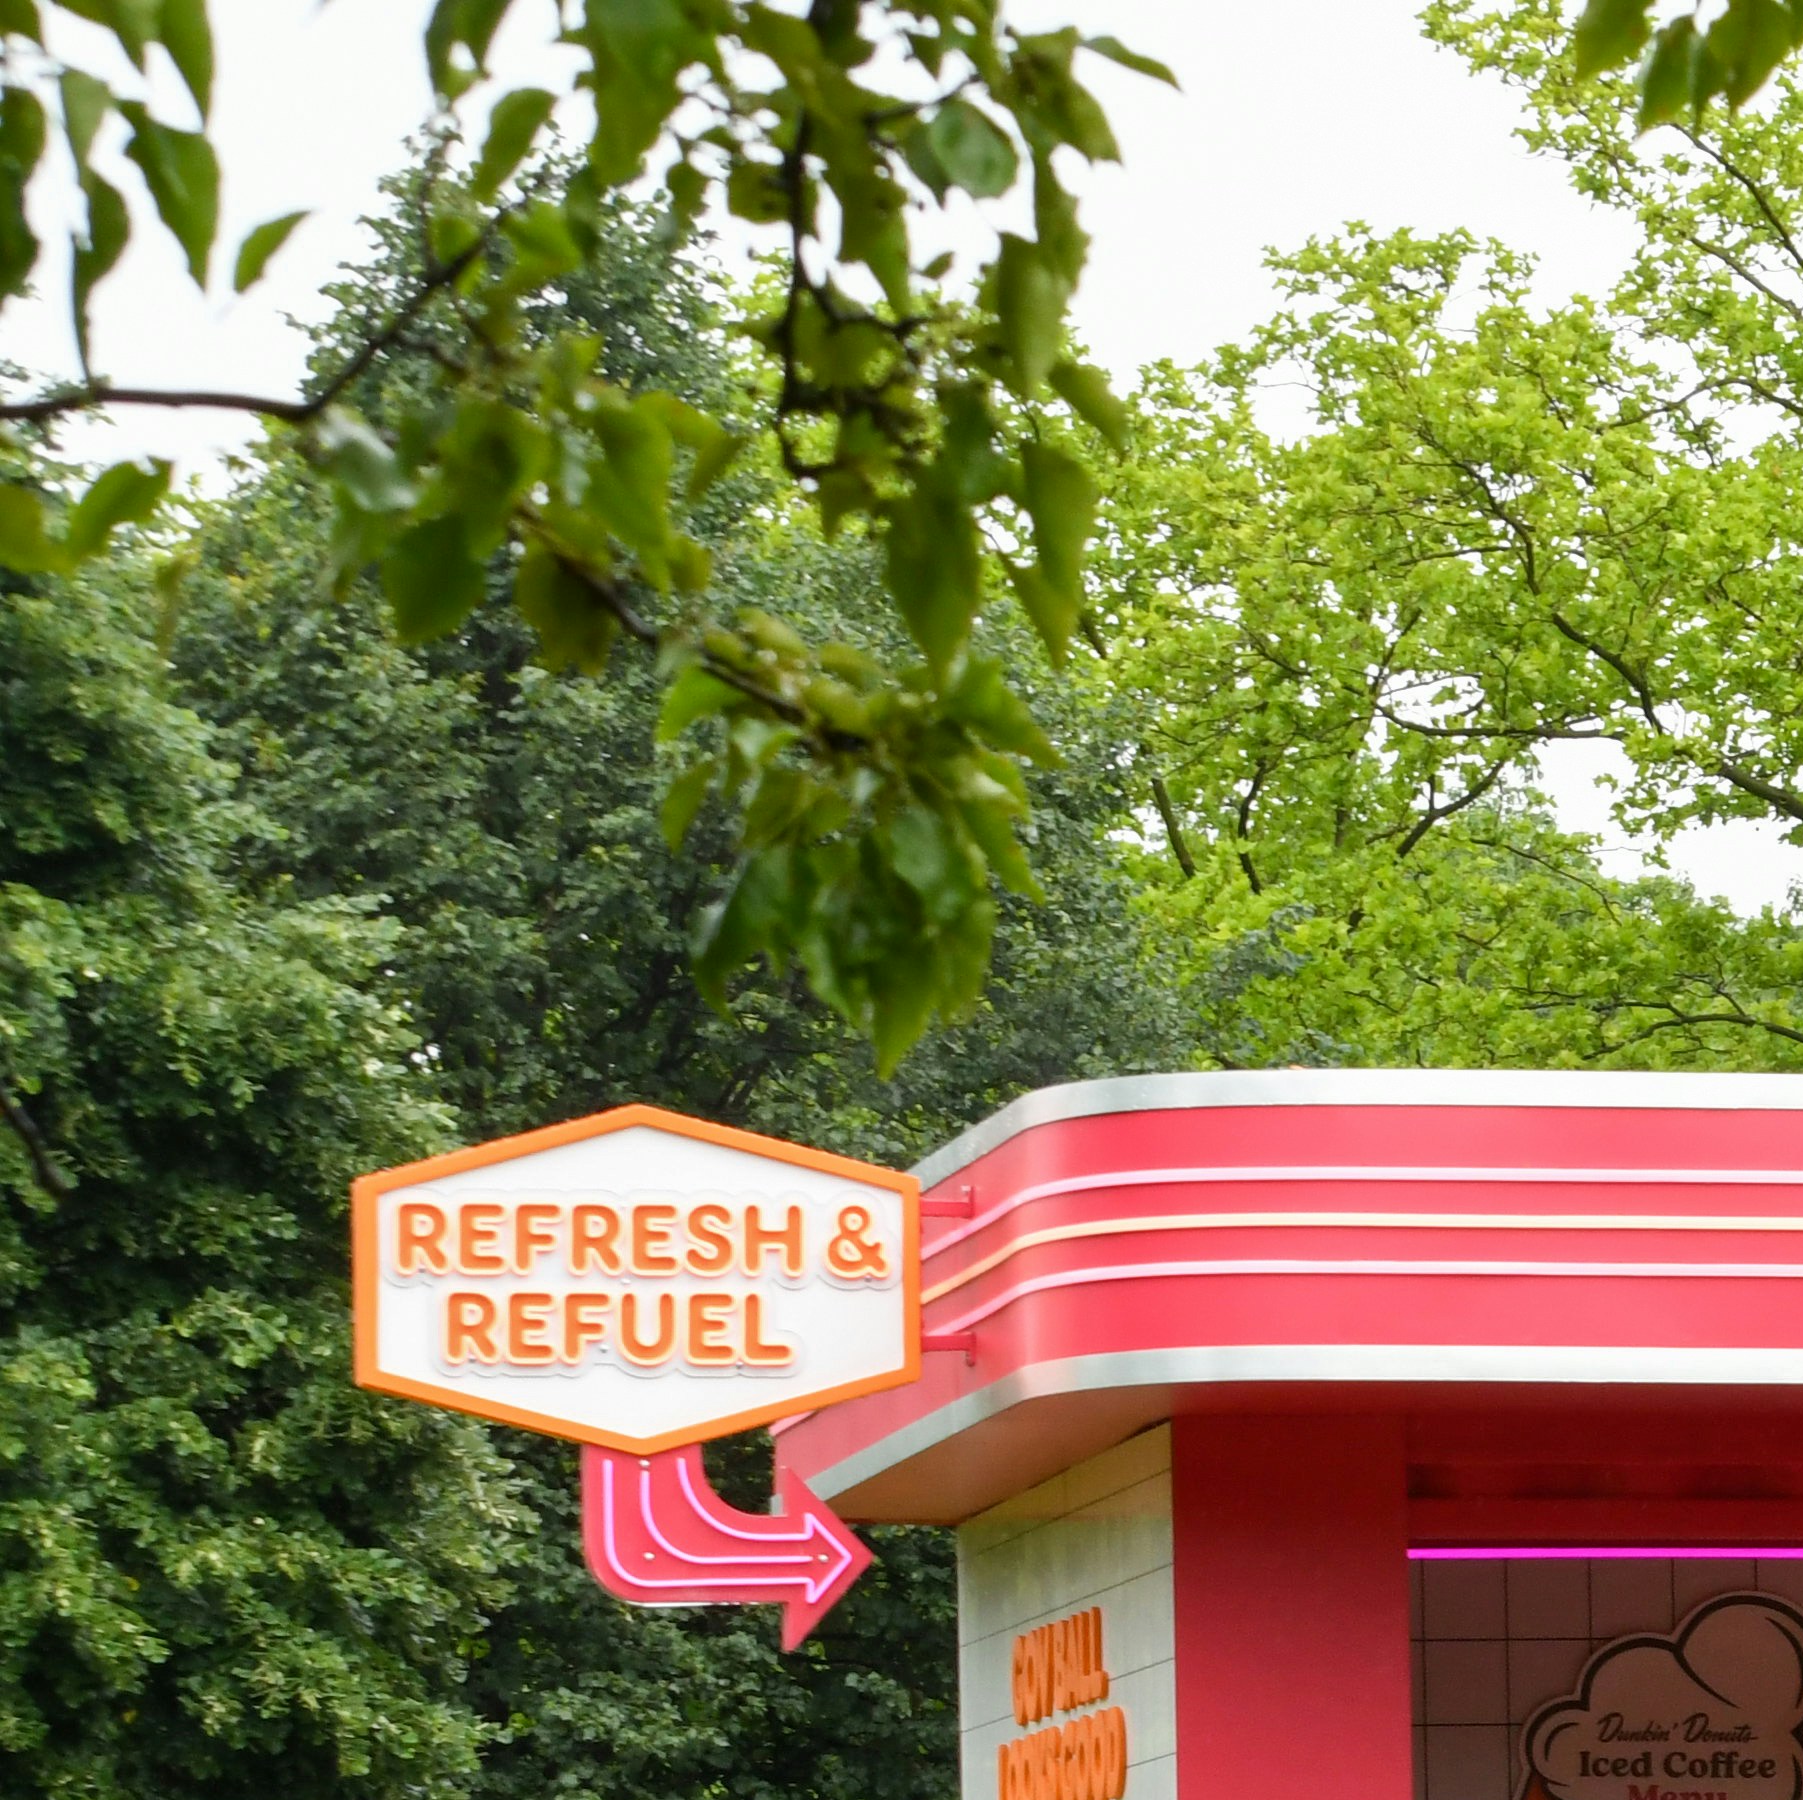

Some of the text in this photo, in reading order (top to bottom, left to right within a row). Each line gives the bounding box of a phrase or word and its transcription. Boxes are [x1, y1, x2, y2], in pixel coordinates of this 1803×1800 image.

[396, 1203, 889, 1278] REFRESH &
[445, 1293, 794, 1366] REFUEL
[1597, 1712, 1760, 1743] Dunkin' Donuts
[1579, 1751, 1776, 1778] Iced Coffee
